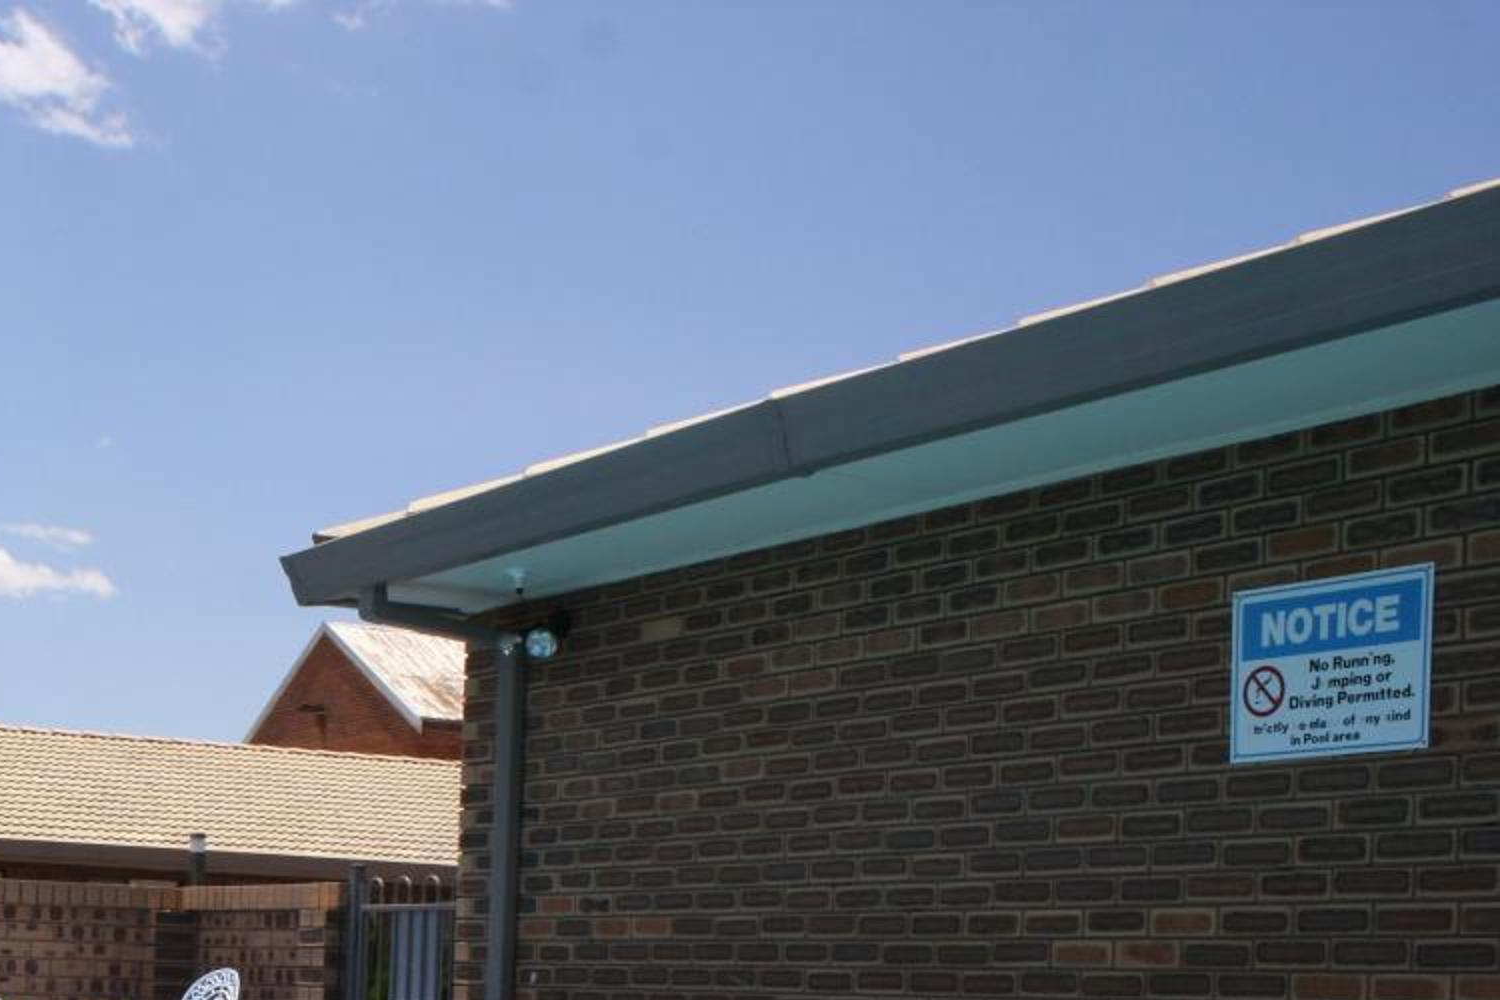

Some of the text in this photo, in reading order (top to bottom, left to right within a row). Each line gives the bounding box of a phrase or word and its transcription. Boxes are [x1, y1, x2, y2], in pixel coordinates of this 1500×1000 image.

[1260, 594, 1400, 648] NOTICE
[1309, 658, 1329, 673] No
[1311, 671, 1393, 690] Jmping or
[1289, 693, 1333, 710] Diving
[1343, 711, 1356, 727] of
